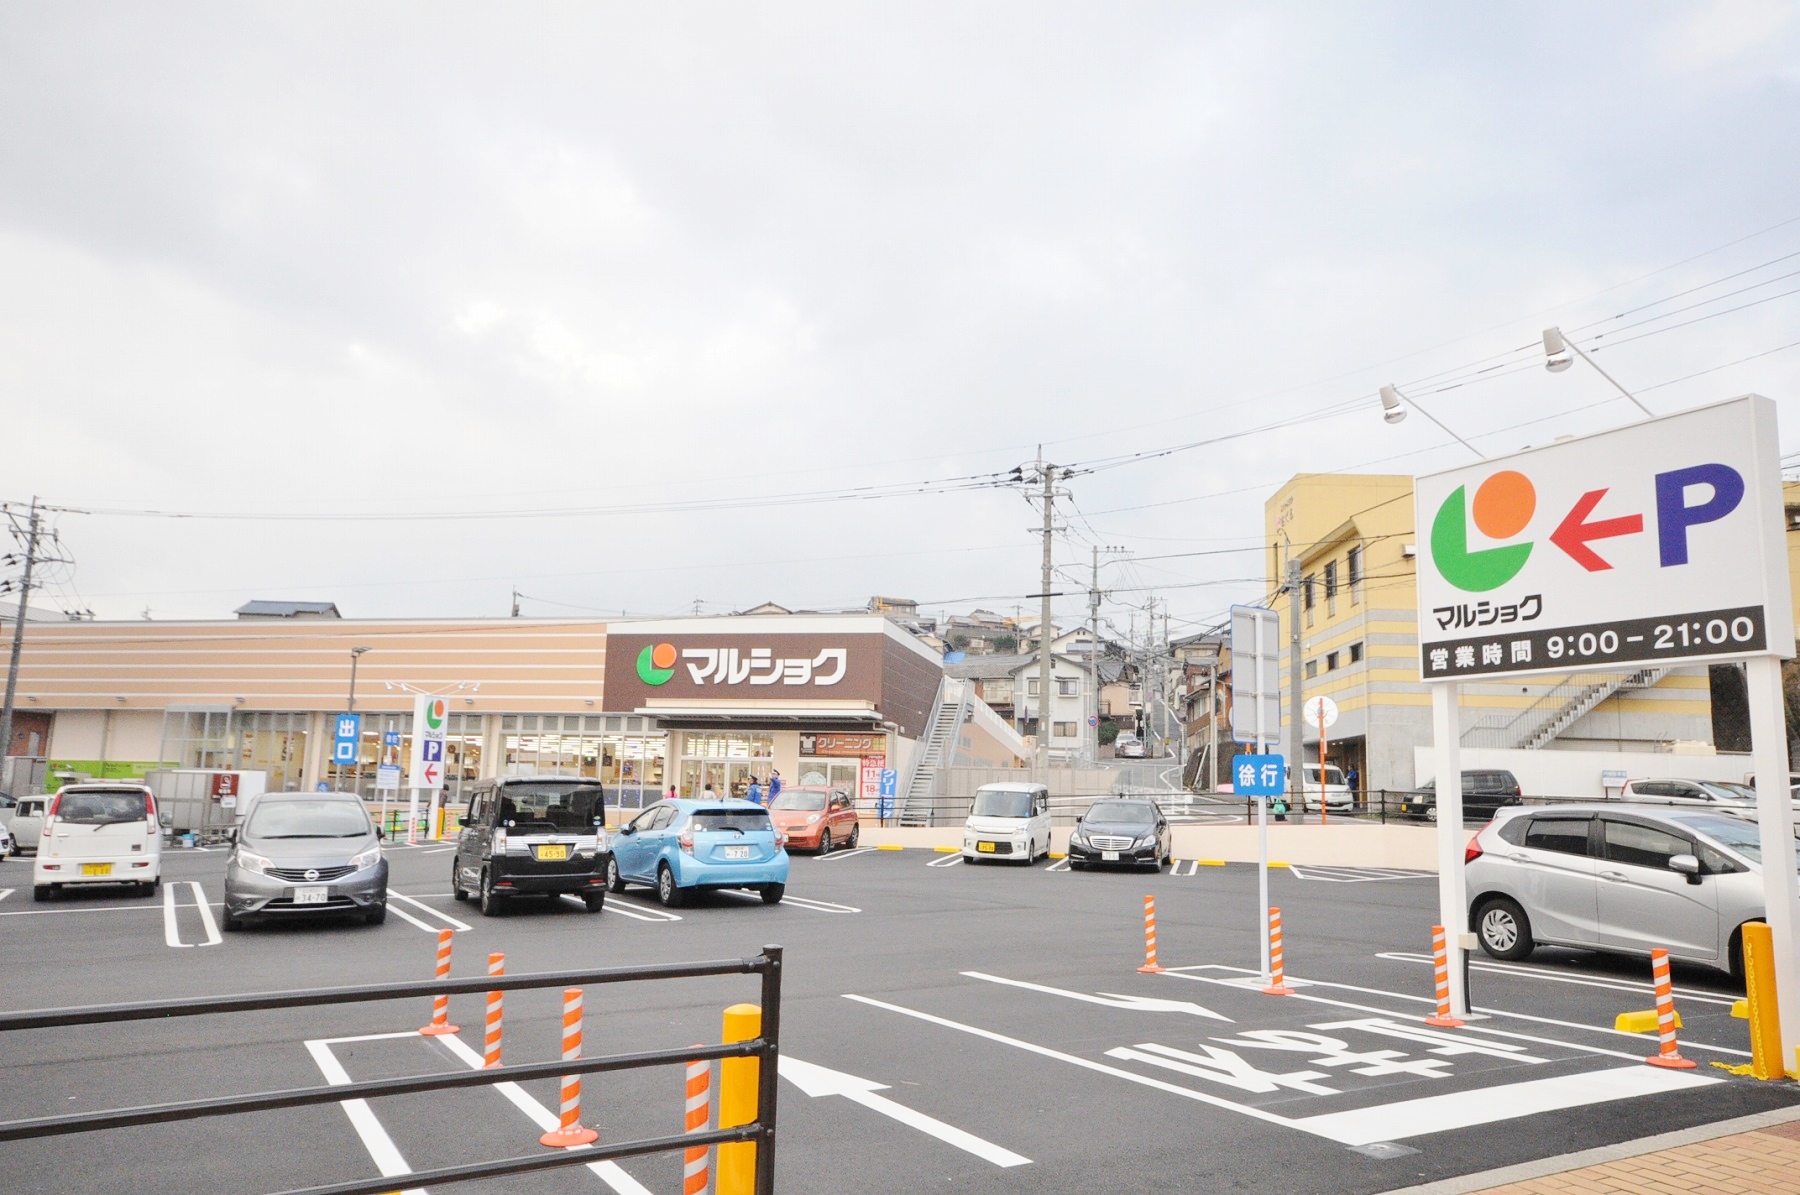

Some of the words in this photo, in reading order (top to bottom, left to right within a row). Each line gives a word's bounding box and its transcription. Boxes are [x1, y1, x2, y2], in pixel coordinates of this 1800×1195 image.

[1655, 462, 1745, 568] P
[1432, 594, 1543, 632] マルショク
[1430, 639, 1532, 671] 営業時間
[1546, 630, 1619, 660] 9:00
[1654, 617, 1755, 650] 21:00
[682, 648, 847, 686] マルショク
[337, 719, 355, 759] 出口
[428, 741, 440, 761] P
[818, 737, 872, 750] クリーニング
[1238, 763, 1279, 787] 徐行
[544, 850, 565, 858] 45-90
[301, 893, 326, 902] 34-70
